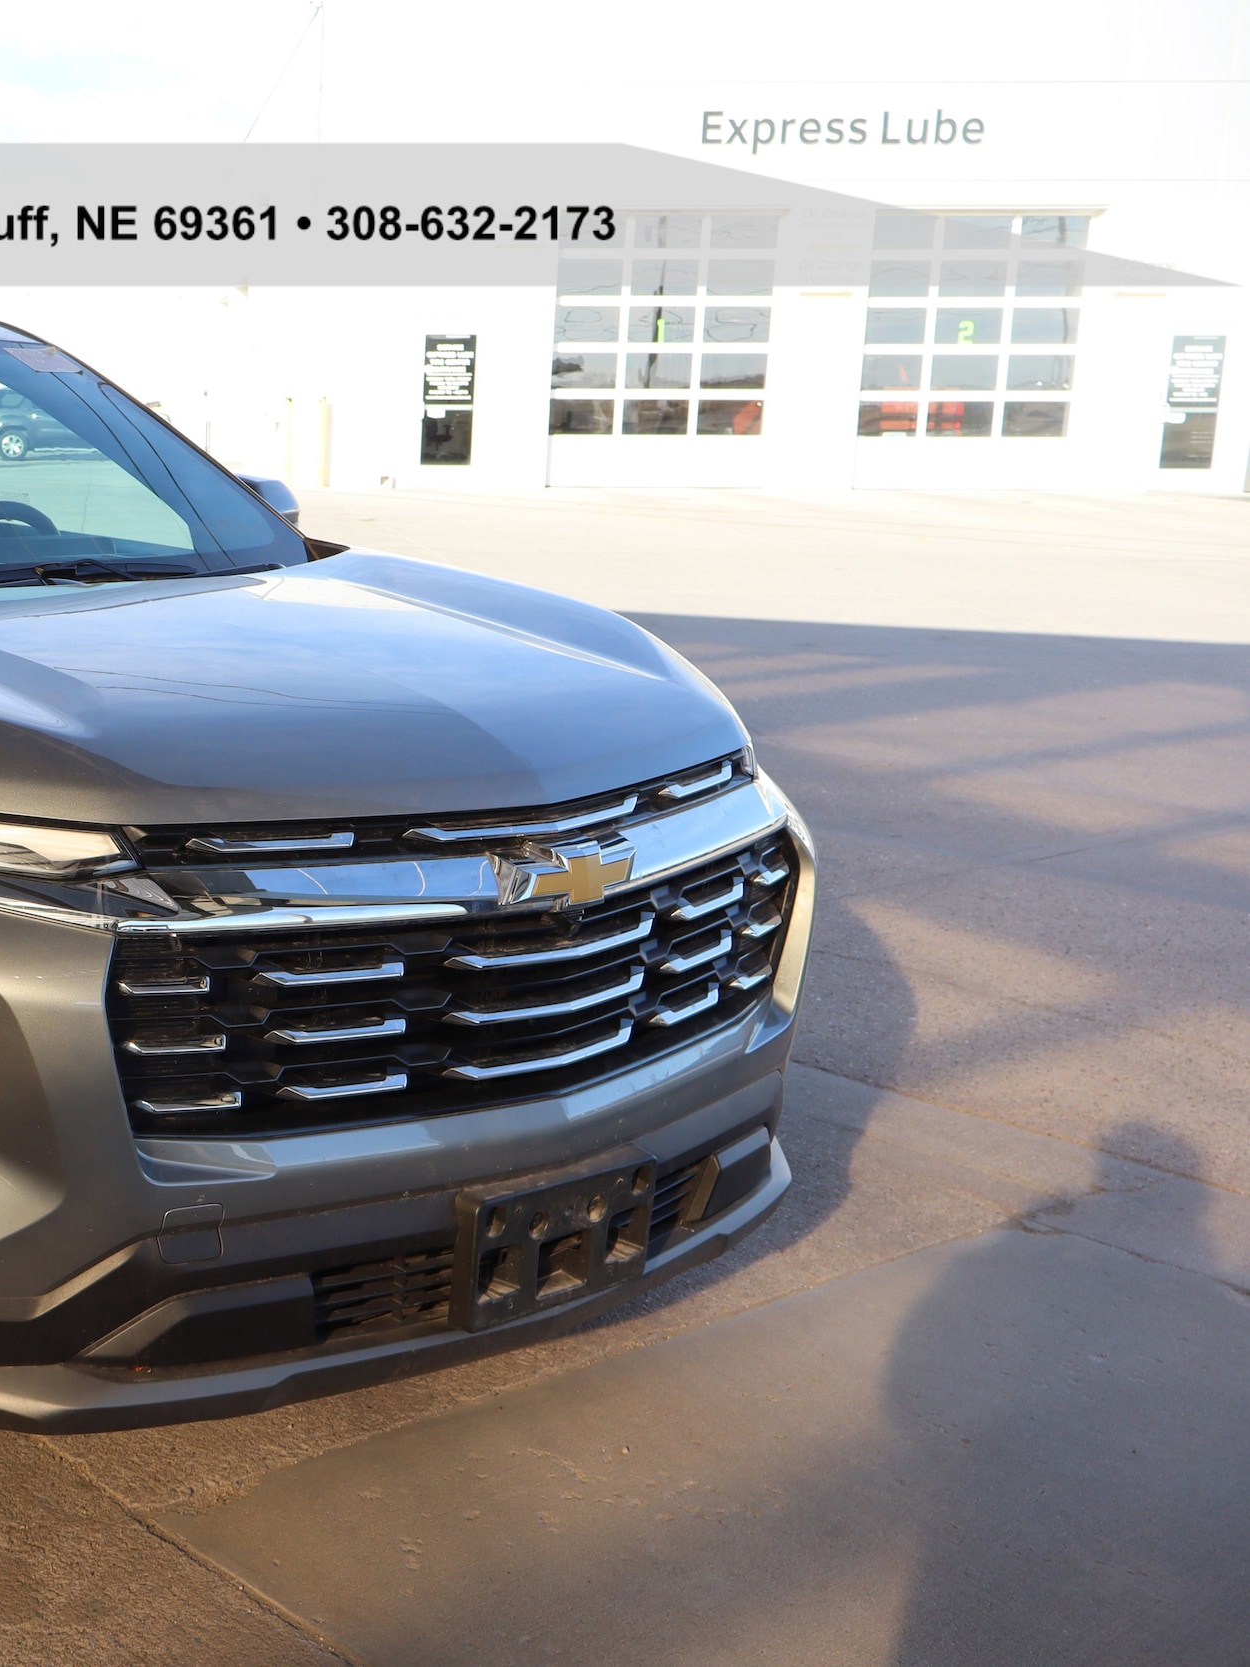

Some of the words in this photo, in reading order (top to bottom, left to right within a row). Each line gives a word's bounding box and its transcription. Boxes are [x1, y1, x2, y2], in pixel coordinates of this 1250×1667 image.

[701, 110, 867, 155] Express
[881, 108, 985, 145] Lube
[957, 319, 975, 344] 2
